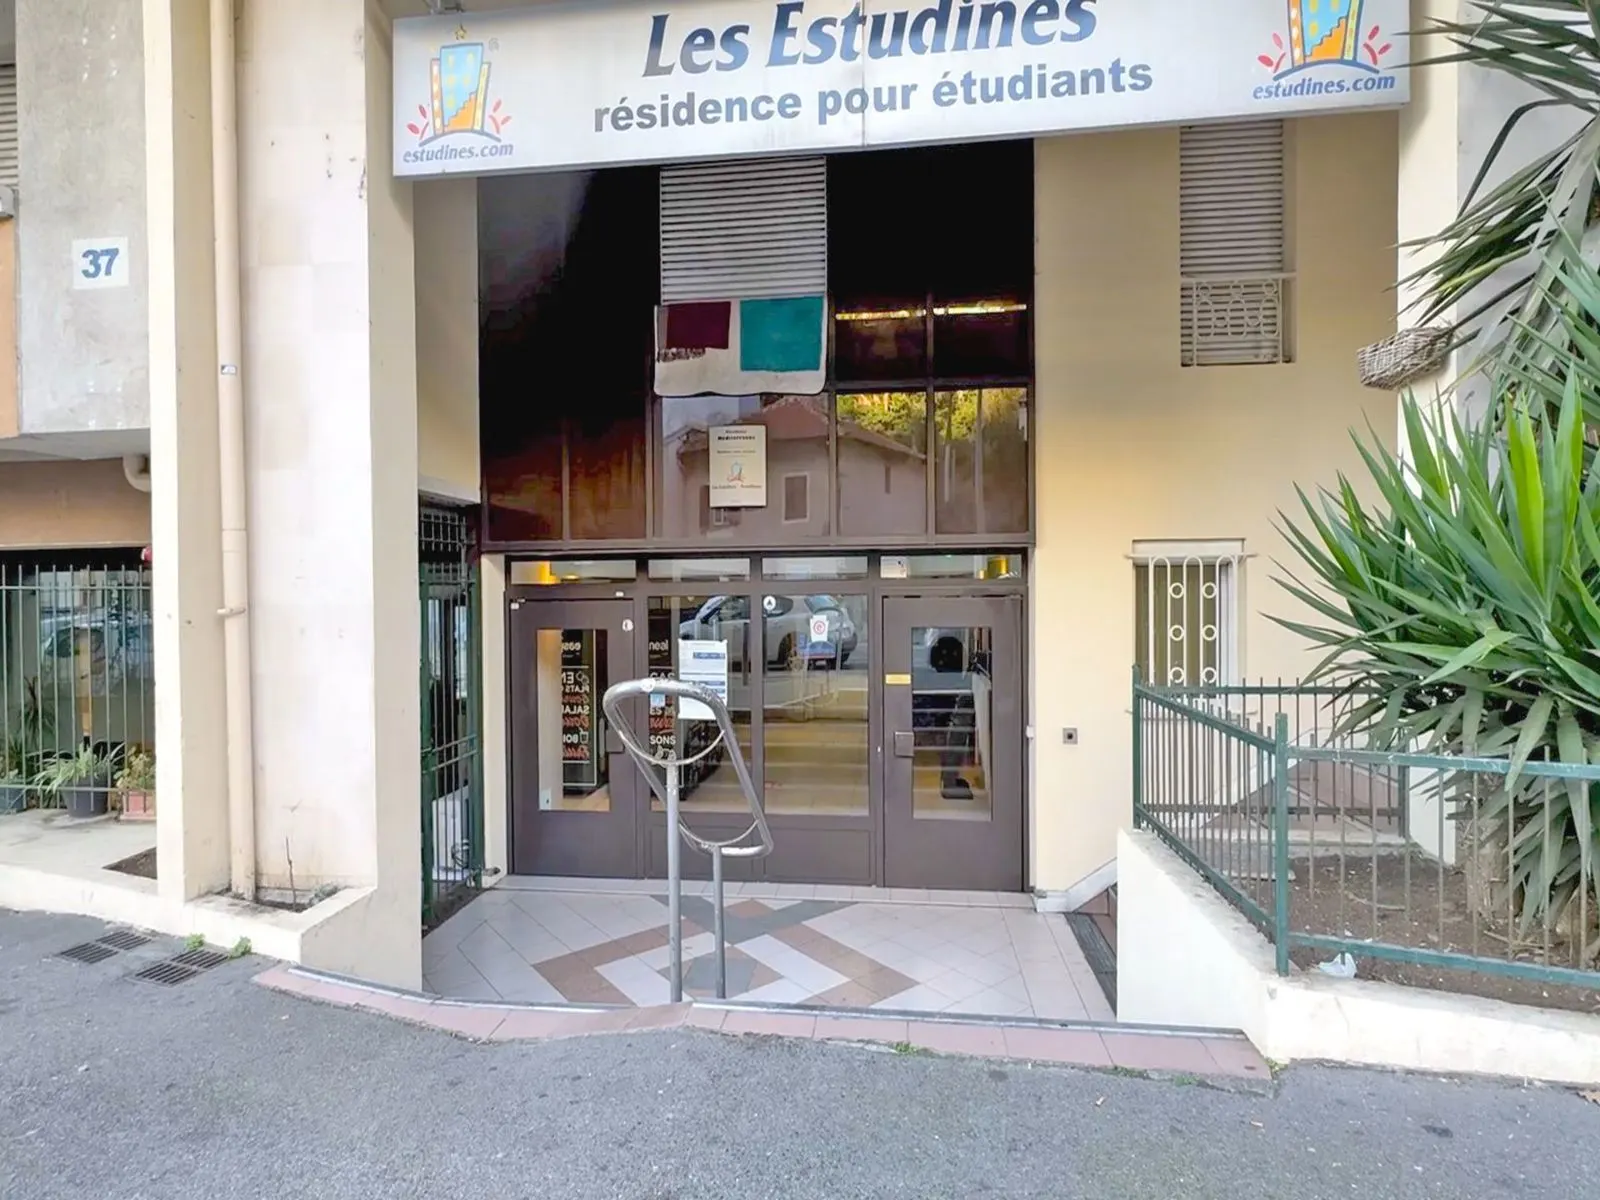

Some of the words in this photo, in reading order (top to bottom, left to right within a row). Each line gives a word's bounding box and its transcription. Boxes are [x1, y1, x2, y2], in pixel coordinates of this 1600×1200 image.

[642, 13, 750, 79] Les
[765, 0, 1100, 68] Estudines
[594, 91, 802, 133] résidence
[817, 82, 918, 125] pour
[932, 58, 1154, 108] étudiants
[1252, 75, 1396, 100] estudines.com
[402, 143, 514, 163] estudines.com
[82, 248, 120, 278] 37
[650, 734, 677, 745] SONS
